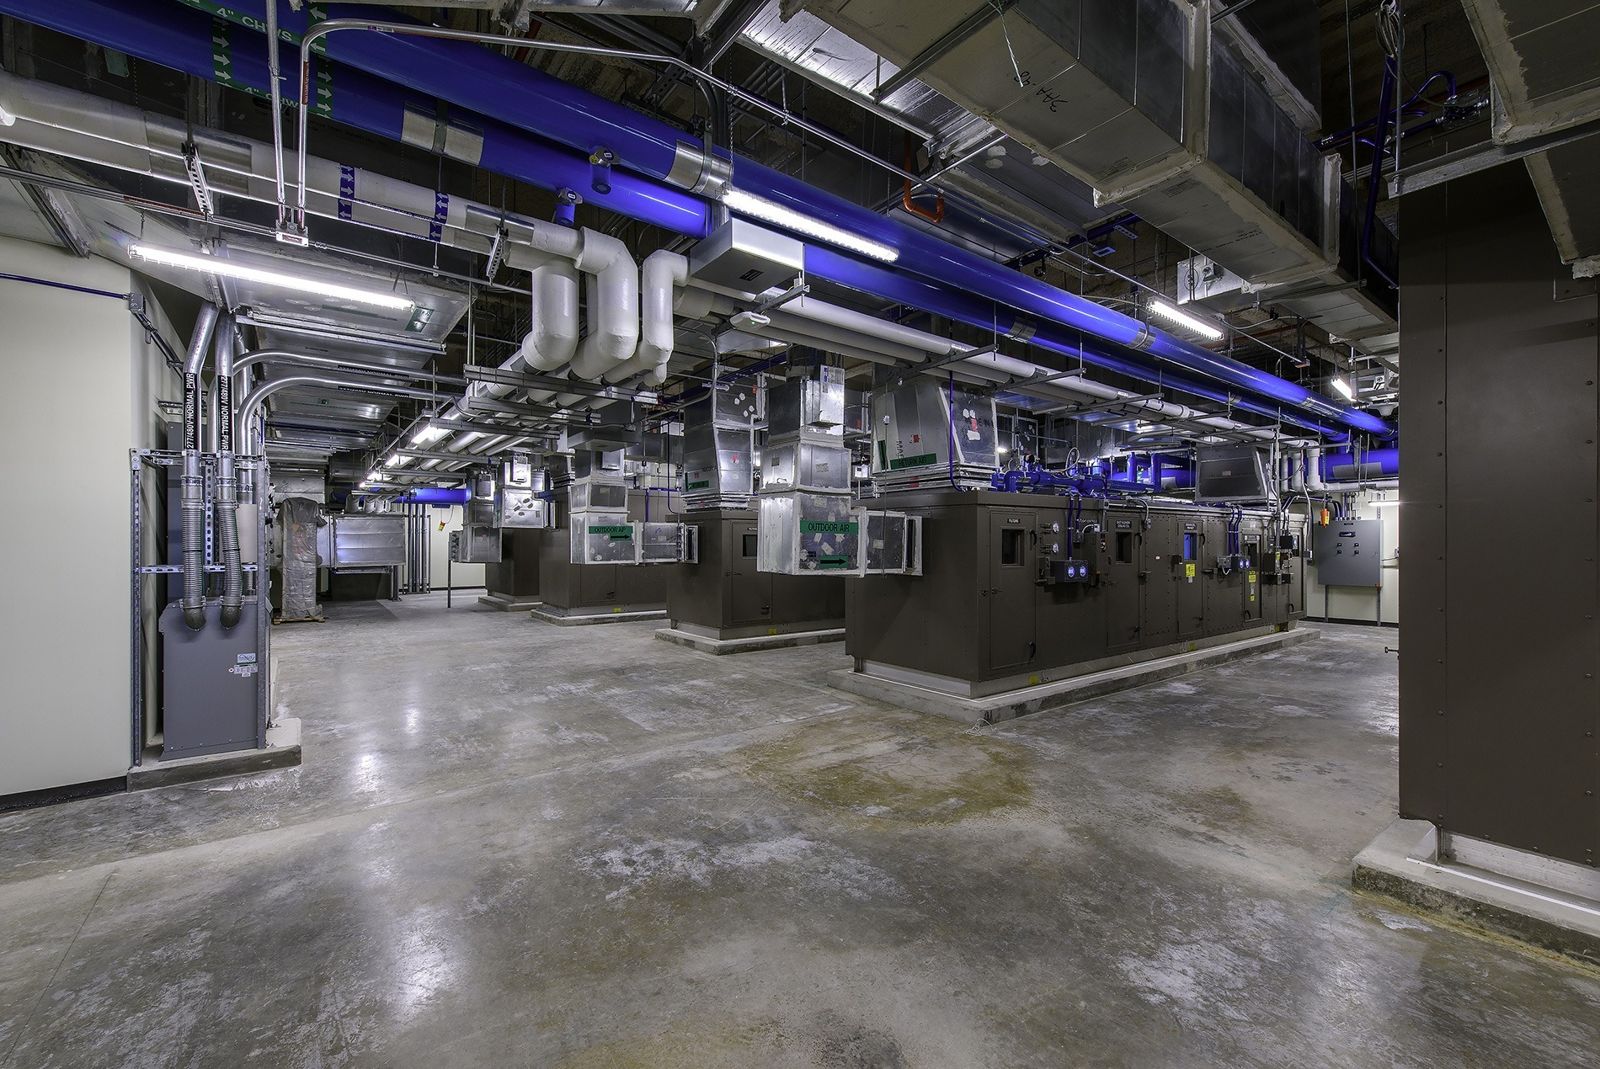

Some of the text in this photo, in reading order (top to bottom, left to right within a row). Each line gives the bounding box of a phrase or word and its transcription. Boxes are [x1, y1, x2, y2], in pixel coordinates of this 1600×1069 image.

[241, 16, 293, 42] CHS
[807, 522, 850, 532] OUTDOOR AIR
